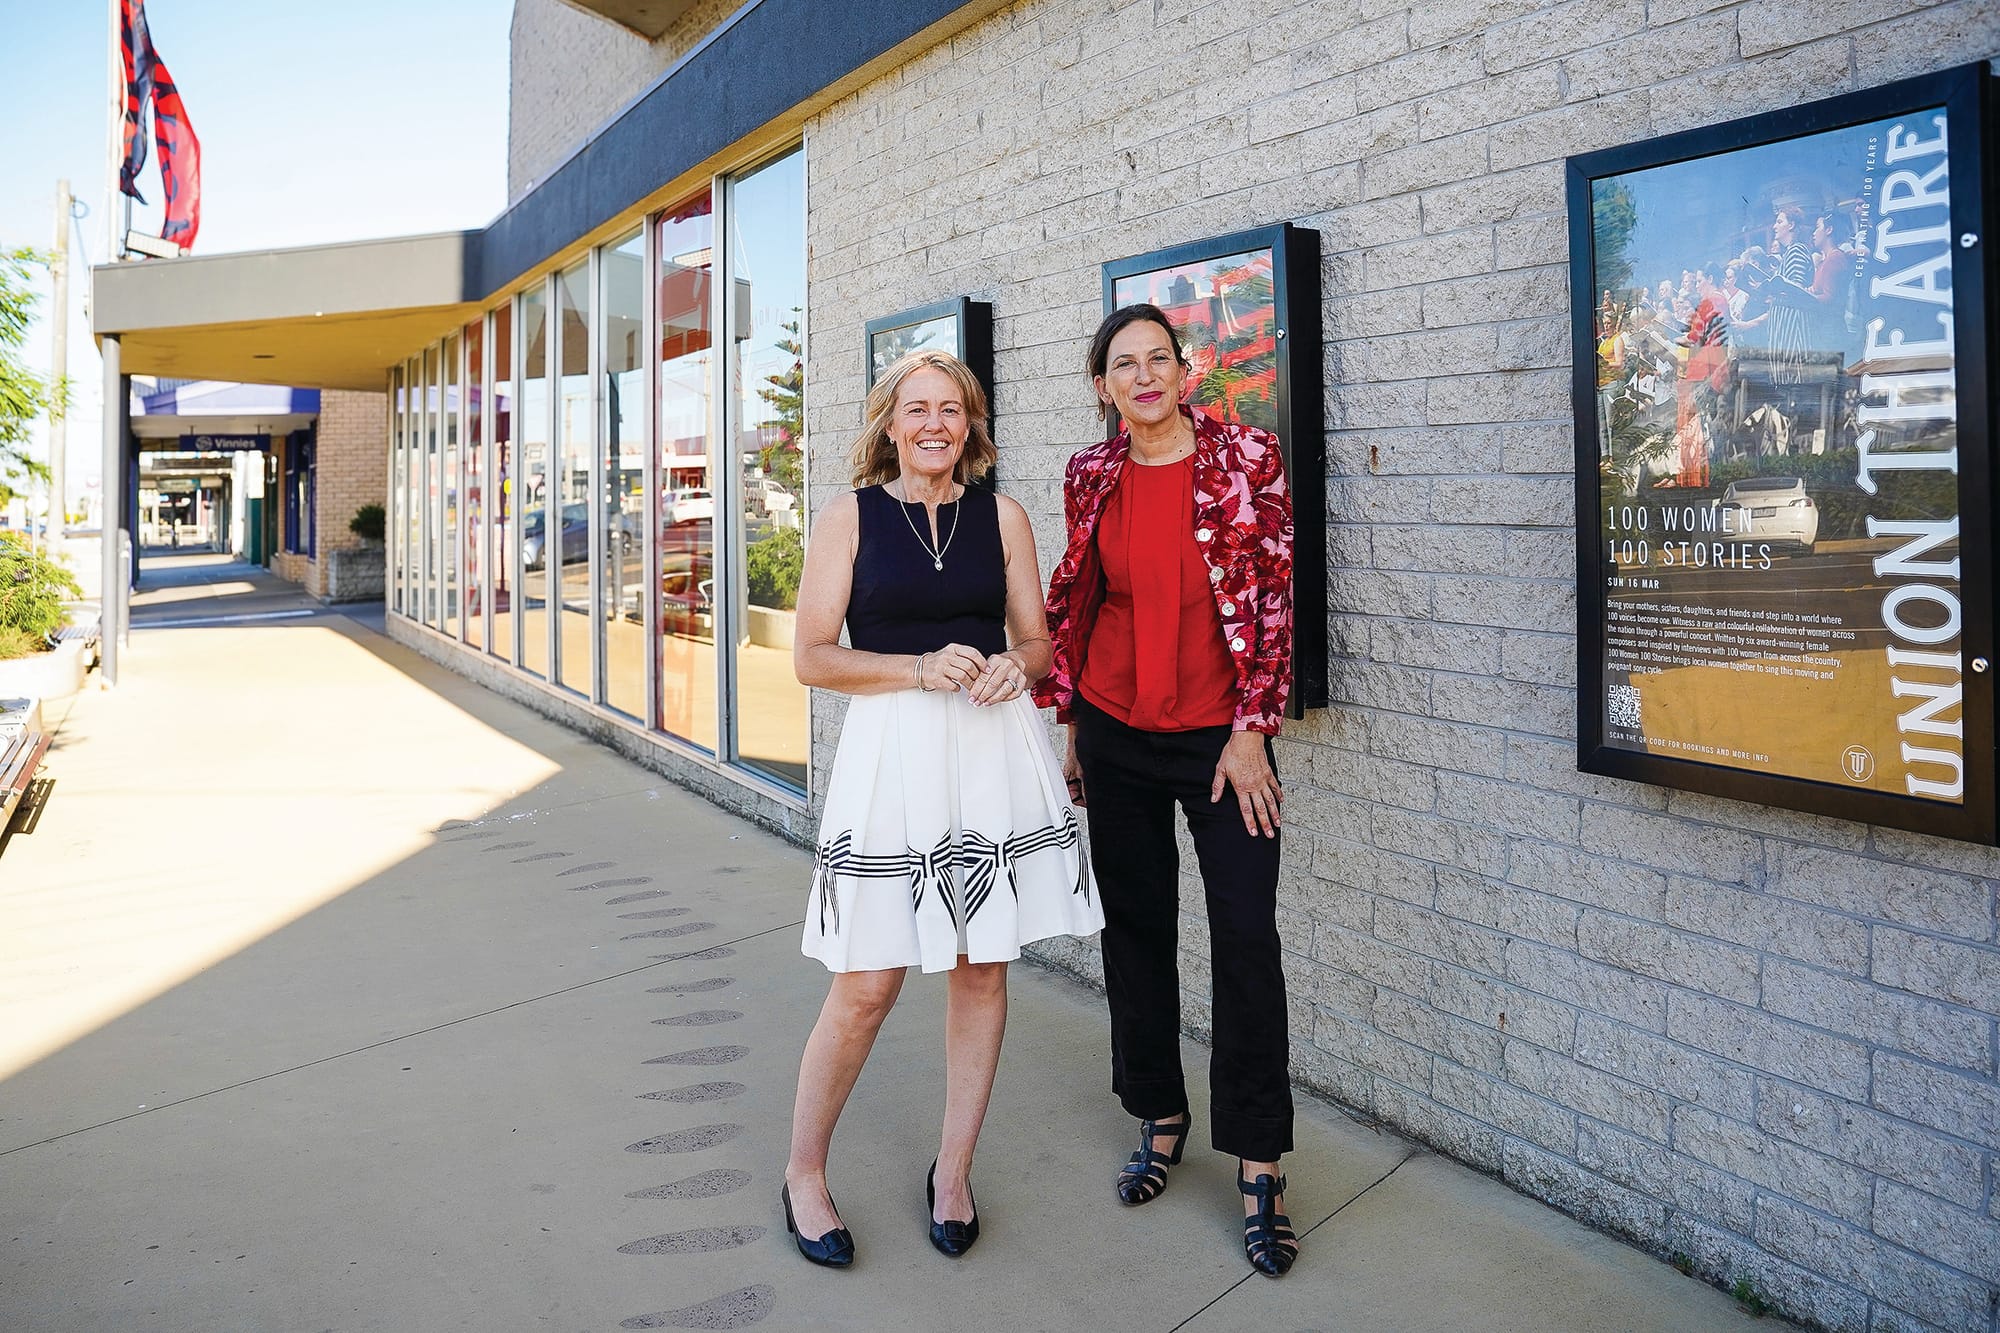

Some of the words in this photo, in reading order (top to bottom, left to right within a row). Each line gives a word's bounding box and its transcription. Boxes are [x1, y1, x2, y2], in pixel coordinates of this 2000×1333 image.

[1866, 137, 1877, 172] YEARS
[1864, 177, 1873, 196] 100
[1856, 116, 1958, 494] THEATRE
[214, 438, 256, 448] Vinnies
[1608, 505, 1648, 531] 100
[1662, 506, 1752, 533] WOMEN
[1608, 539, 1648, 565] 100
[1663, 541, 1771, 570] STORIES
[1607, 577, 1624, 587] SUN
[1628, 578, 1638, 588] 16
[1641, 579, 1660, 589] MAR
[1608, 600, 1622, 609] Bring
[1623, 602, 1635, 610] your
[1636, 602, 1660, 612] mothers,
[1662, 604, 1682, 613] sisters,
[1683, 605, 1714, 616] daughters,
[1716, 608, 1728, 616] and
[1729, 608, 1750, 618] friends
[1752, 610, 1764, 618] and
[1766, 610, 1780, 622] step
[1782, 612, 1794, 621] into
[1802, 614, 1819, 623] world
[1821, 616, 1842, 624] where
[1608, 612, 1618, 620] 100
[1619, 613, 1636, 621] voices
[1638, 614, 1658, 624] become
[1672, 617, 1695, 626] Witness
[1714, 621, 1726, 629] and
[1727, 622, 1754, 632] colourful
[1756, 624, 1796, 635] collaboration
[1798, 627, 1805, 635] of
[1806, 629, 1830, 638] women
[1832, 631, 1856, 640] across
[1608, 624, 1616, 632] the
[1618, 626, 1635, 634] nation
[1636, 627, 1658, 637] through
[1664, 630, 1688, 638] powerful
[1714, 634, 1736, 643] Written
[1738, 636, 1744, 646] by
[1746, 636, 1754, 644] six
[1756, 637, 1804, 651] award-winning
[1806, 641, 1830, 652] female
[1608, 638, 1636, 647] composers
[1650, 642, 1672, 652] inspired
[1673, 643, 1680, 652] by
[1681, 644, 1711, 654] interviews
[1712, 646, 1725, 655] with
[1728, 648, 1738, 656] 100
[1740, 650, 1761, 658] women
[1764, 650, 1778, 660] from
[1780, 654, 1801, 662] across
[1802, 654, 1814, 663] the
[1608, 649, 1618, 657] 100
[1619, 650, 1639, 660] Women
[1640, 652, 1651, 660] 100
[1652, 654, 1671, 663] Stories
[1673, 655, 1690, 666] brings
[1692, 657, 1706, 666] local
[1708, 660, 1728, 668] women
[1730, 661, 1755, 672] together
[1757, 664, 1763, 672] to
[1765, 665, 1779, 675] sing
[1780, 666, 1792, 675] this
[1794, 668, 1818, 680] moving
[1820, 671, 1834, 680] and
[1608, 662, 1632, 671] poignant
[1633, 665, 1646, 674] song
[1865, 514, 1963, 797] UNION
[1609, 731, 1624, 740] SCAN
[1626, 734, 1637, 743] THE
[1638, 736, 1646, 744] QR
[1650, 738, 1666, 747] CODE
[1668, 740, 1680, 749] FOR
[1682, 742, 1714, 754] BOOKINGS
[1716, 747, 1730, 756] AND
[1732, 750, 1750, 760] MORE
[1752, 753, 1769, 763] INFO
